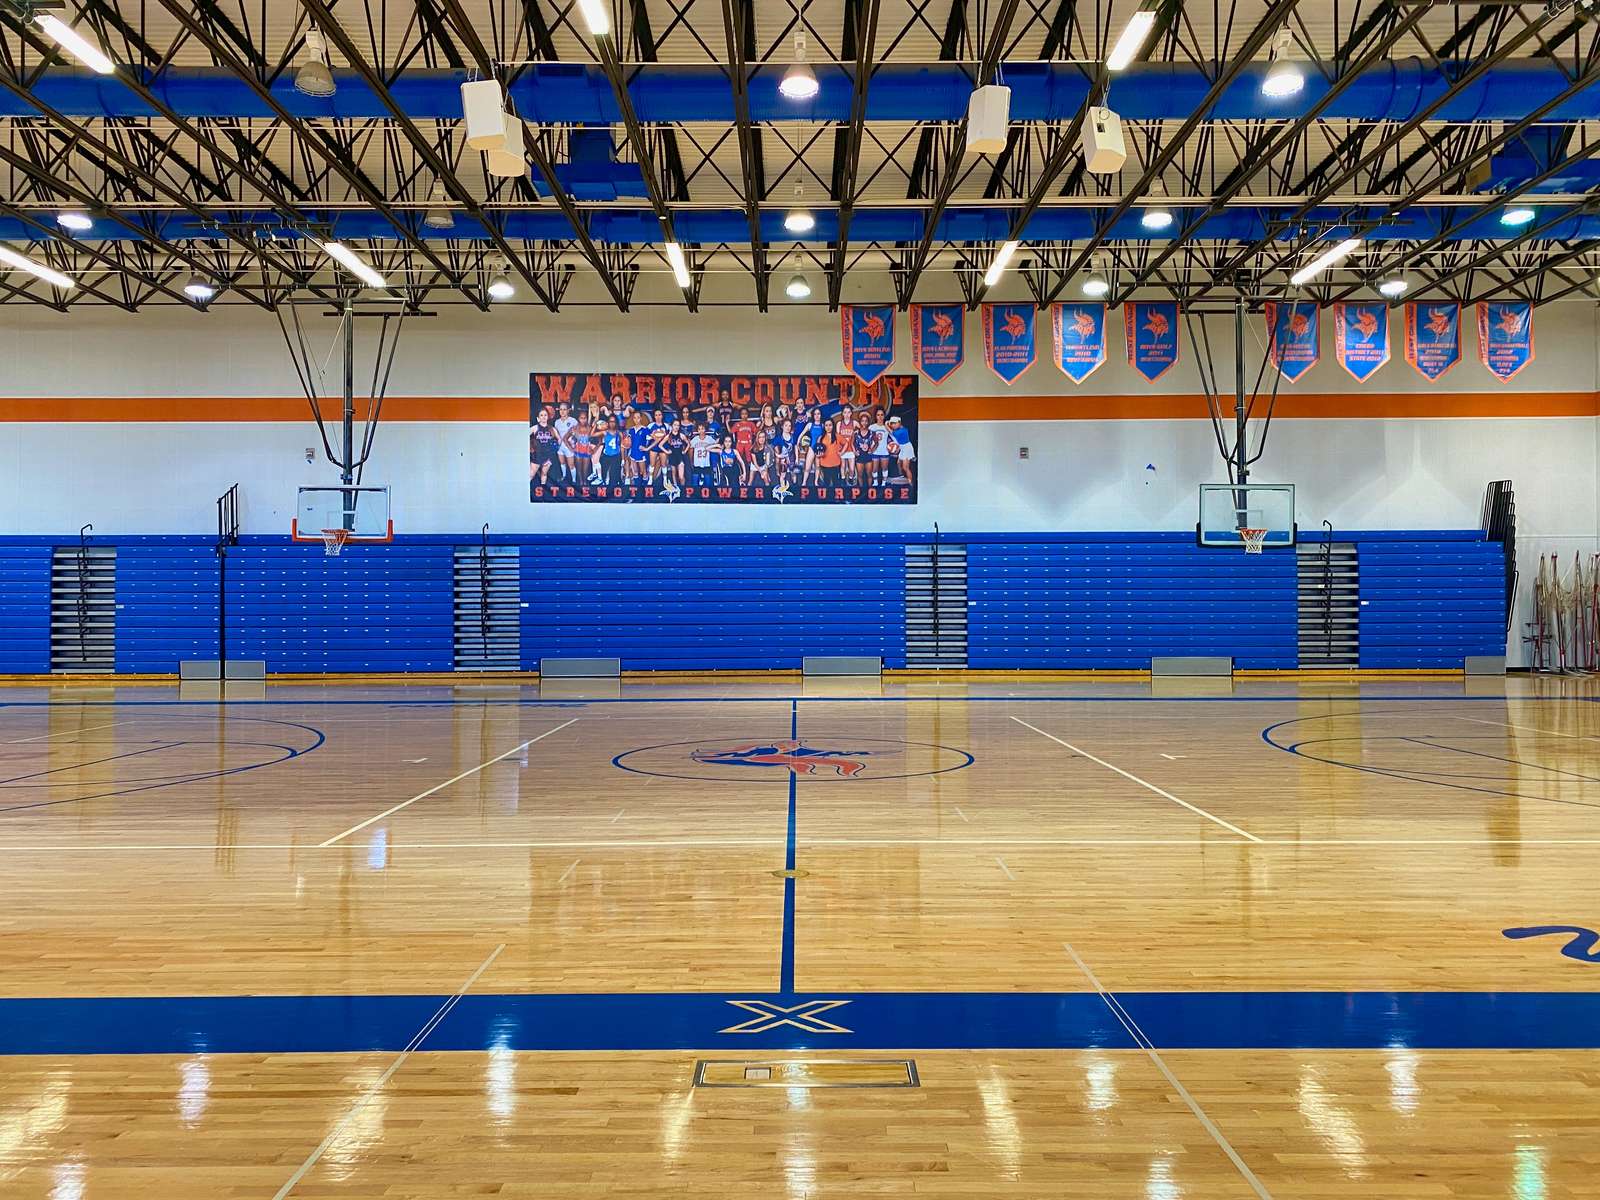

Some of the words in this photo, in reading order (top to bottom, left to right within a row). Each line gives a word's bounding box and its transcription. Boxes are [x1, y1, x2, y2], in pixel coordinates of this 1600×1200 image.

[535, 375, 720, 404] WARRIOR
[730, 376, 913, 405] COUNTRY
[534, 487, 654, 498] STRENGTH
[685, 487, 764, 499] POWER
[800, 488, 910, 499] PURPOSE
